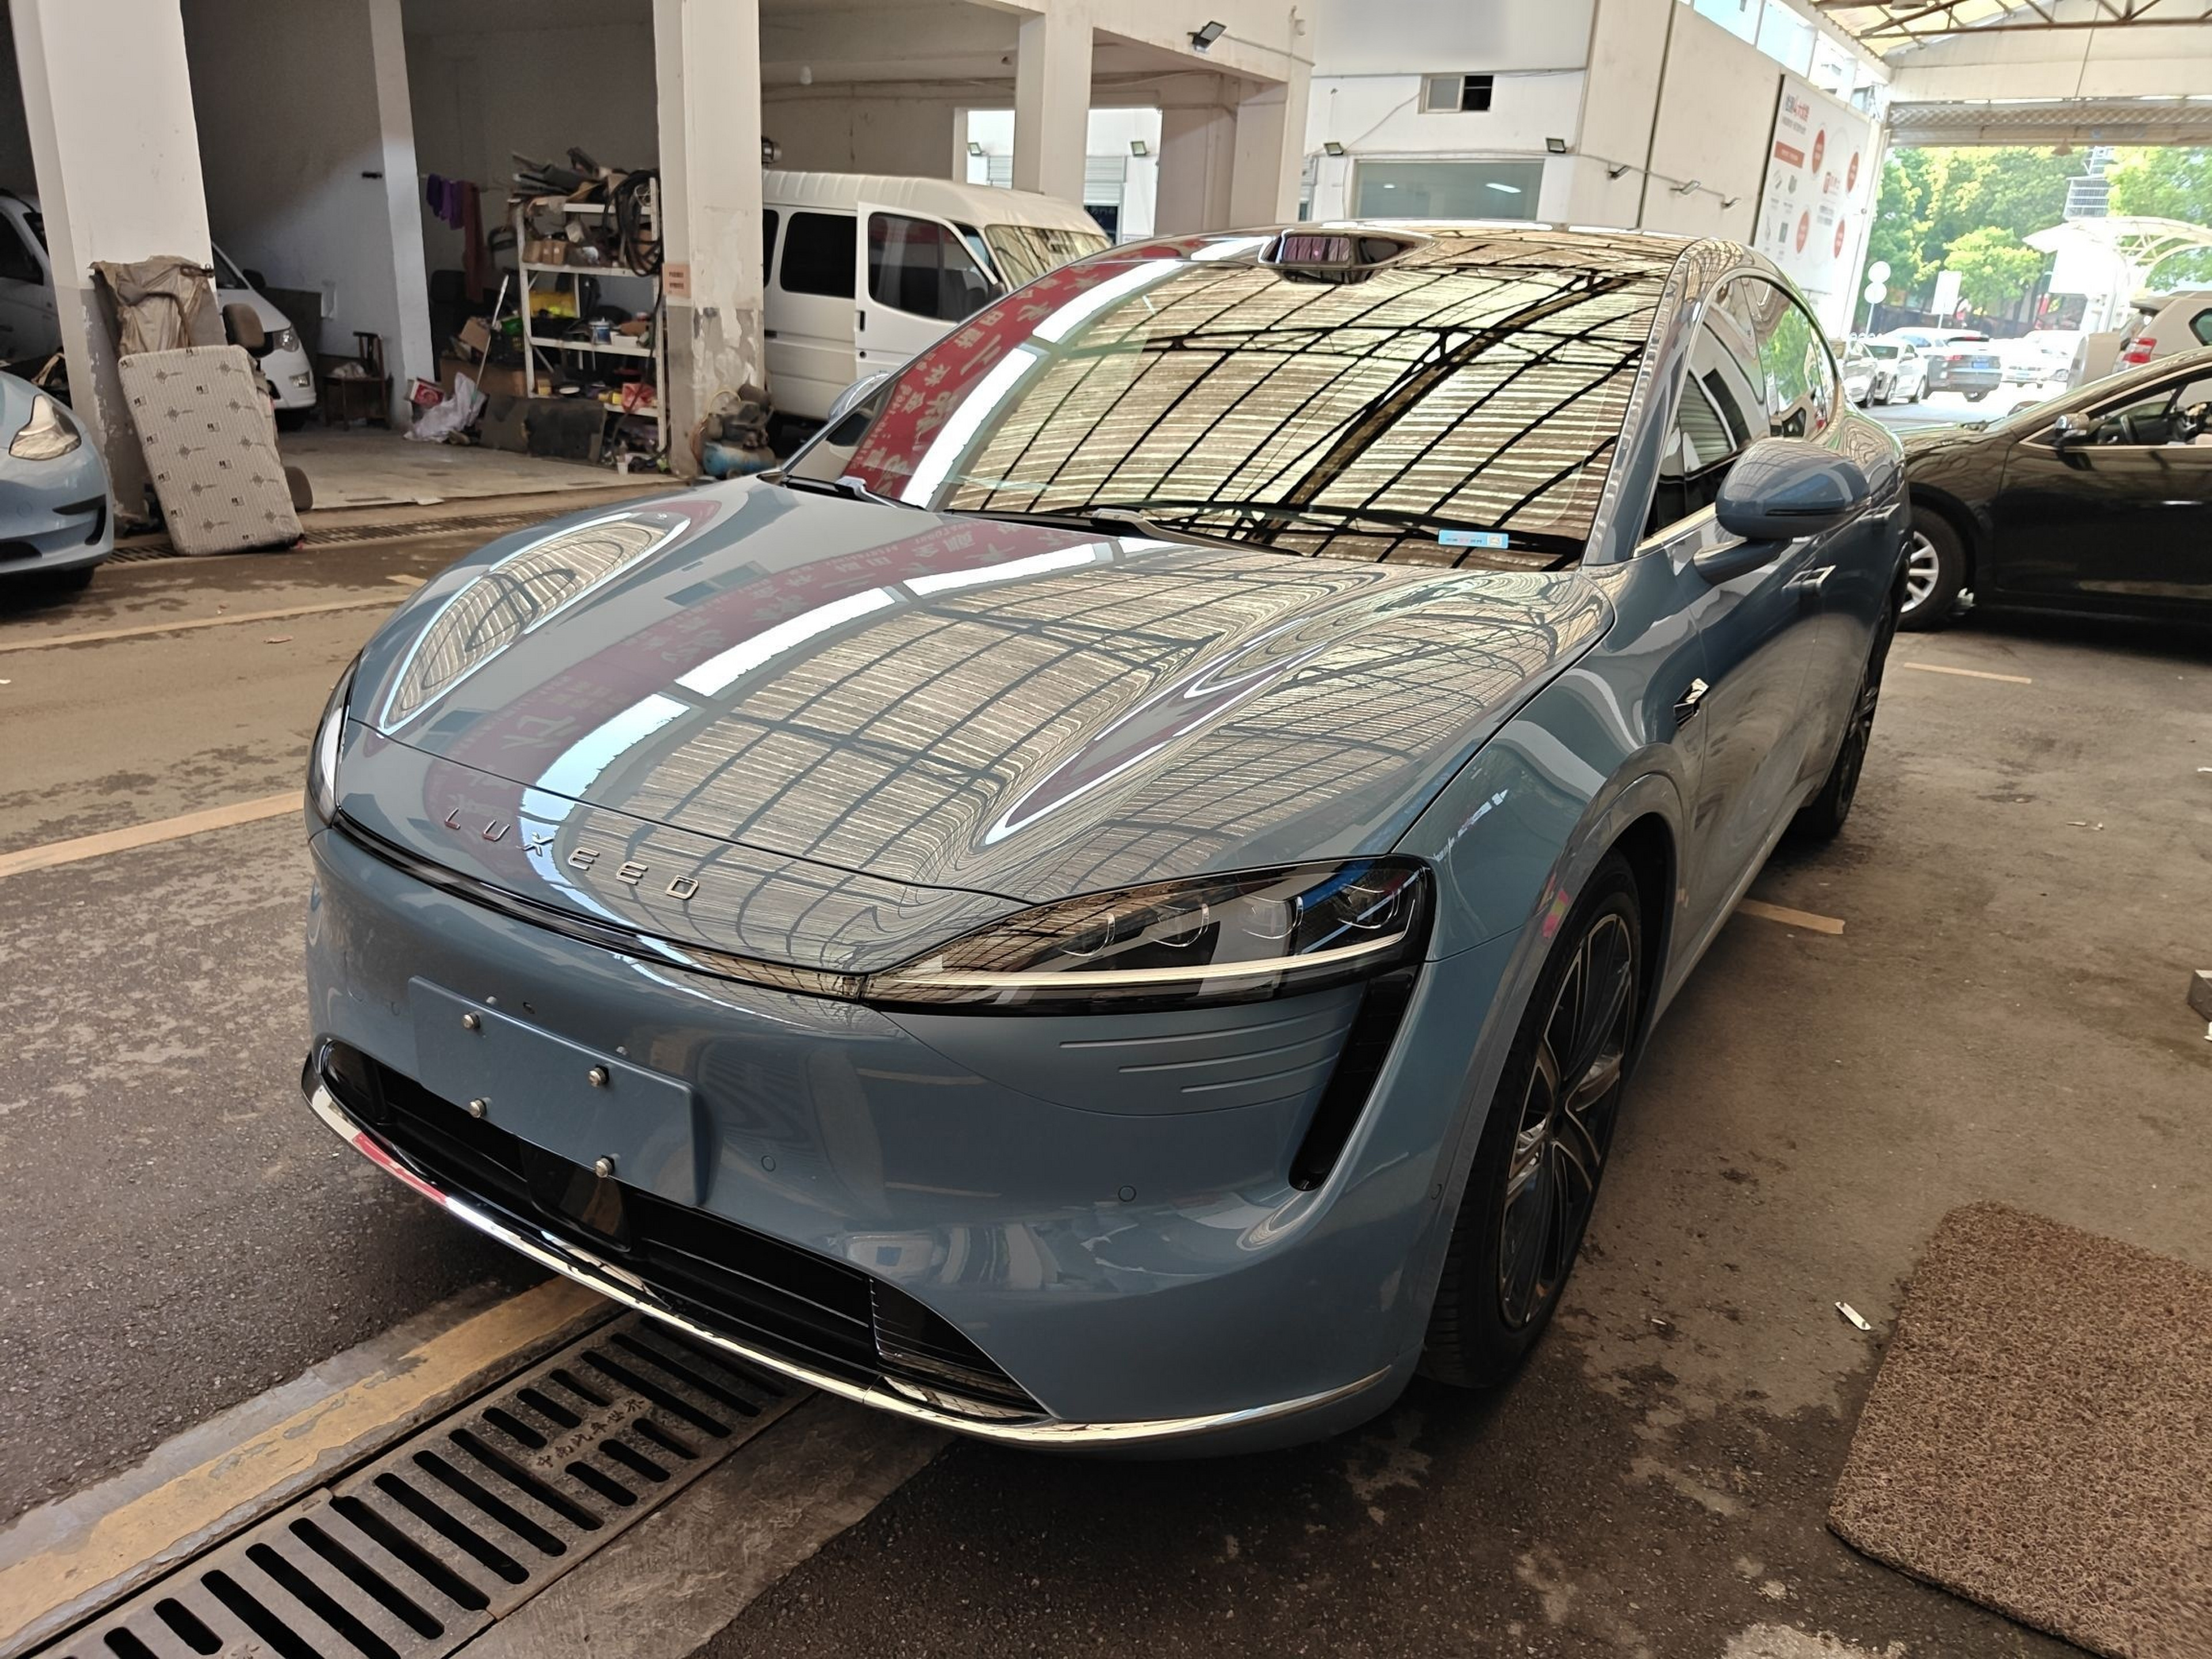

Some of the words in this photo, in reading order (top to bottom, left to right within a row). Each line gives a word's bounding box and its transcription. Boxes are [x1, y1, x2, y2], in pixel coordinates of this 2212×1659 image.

[444, 806, 699, 900] LUXEED
[536, 1397, 645, 1468] 中南汽车世界
